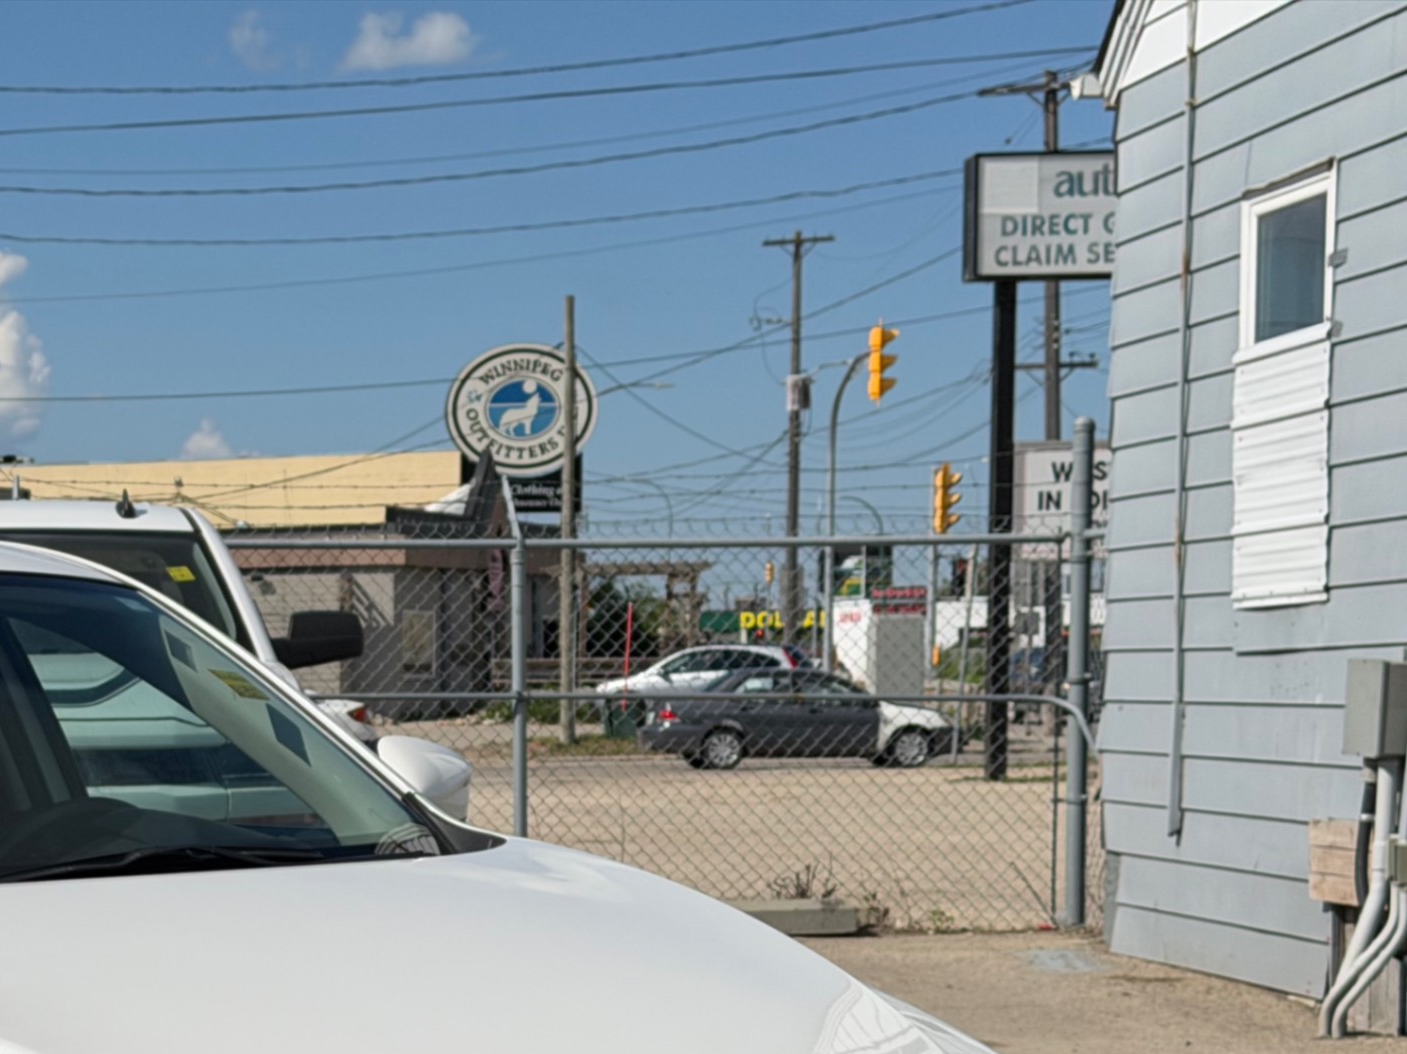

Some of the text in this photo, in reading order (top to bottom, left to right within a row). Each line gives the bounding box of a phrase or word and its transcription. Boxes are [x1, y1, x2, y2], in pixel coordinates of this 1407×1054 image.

[1000, 213, 1093, 237] DIRECT
[994, 243, 1077, 268] CLAIM
[478, 358, 564, 386] WINNIPEG
[466, 408, 559, 460] OUTFITTERS
